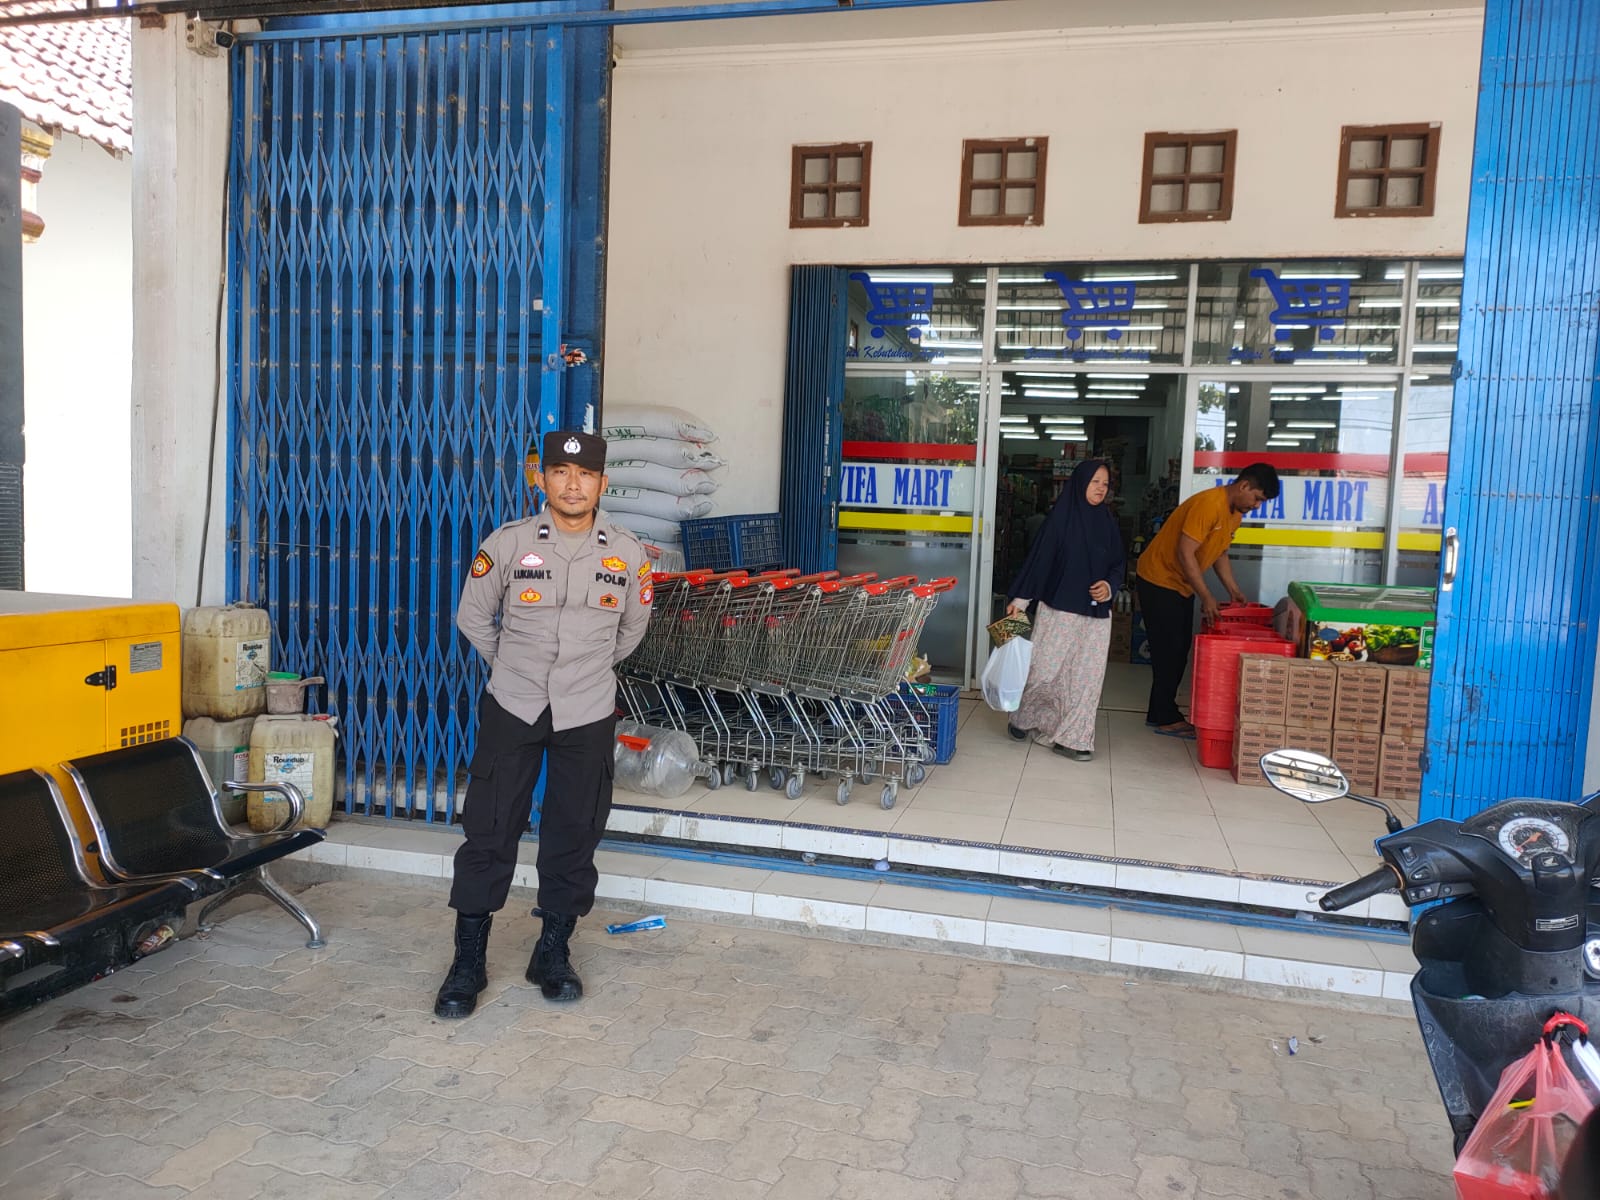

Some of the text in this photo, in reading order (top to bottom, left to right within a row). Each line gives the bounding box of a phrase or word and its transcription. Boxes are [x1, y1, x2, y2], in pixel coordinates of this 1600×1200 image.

[893, 467, 953, 507] MART
[1302, 479, 1369, 522] MART
[514, 569, 544, 579] LUKMAN
[595, 572, 627, 587] POLRI
[273, 755, 304, 764] Roundup
